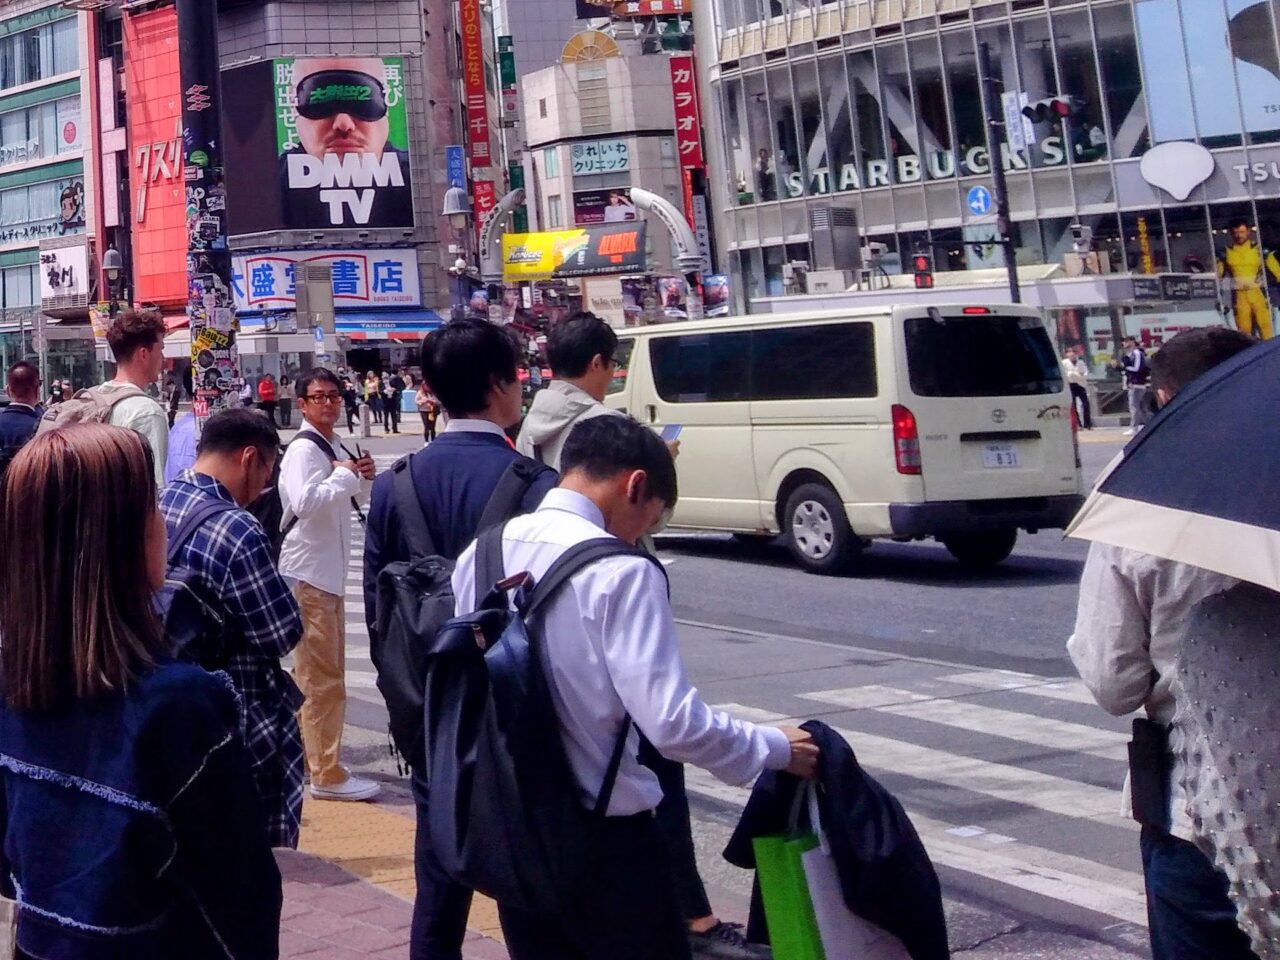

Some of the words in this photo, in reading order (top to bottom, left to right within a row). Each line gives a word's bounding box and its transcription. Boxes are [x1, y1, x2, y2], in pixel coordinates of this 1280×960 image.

[383, 64, 403, 108] 再び
[275, 63, 300, 150] 脱出せよ
[673, 69, 698, 155] カラオケ
[1263, 104, 1280, 114] TS
[468, 93, 489, 159] 三千里
[574, 157, 629, 172] クリニック
[586, 143, 627, 156] れいわ
[785, 136, 1065, 198] STARBUCKS
[287, 151, 405, 189] DMM
[320, 188, 376, 225] TV
[40, 254, 57, 264] うなぎ
